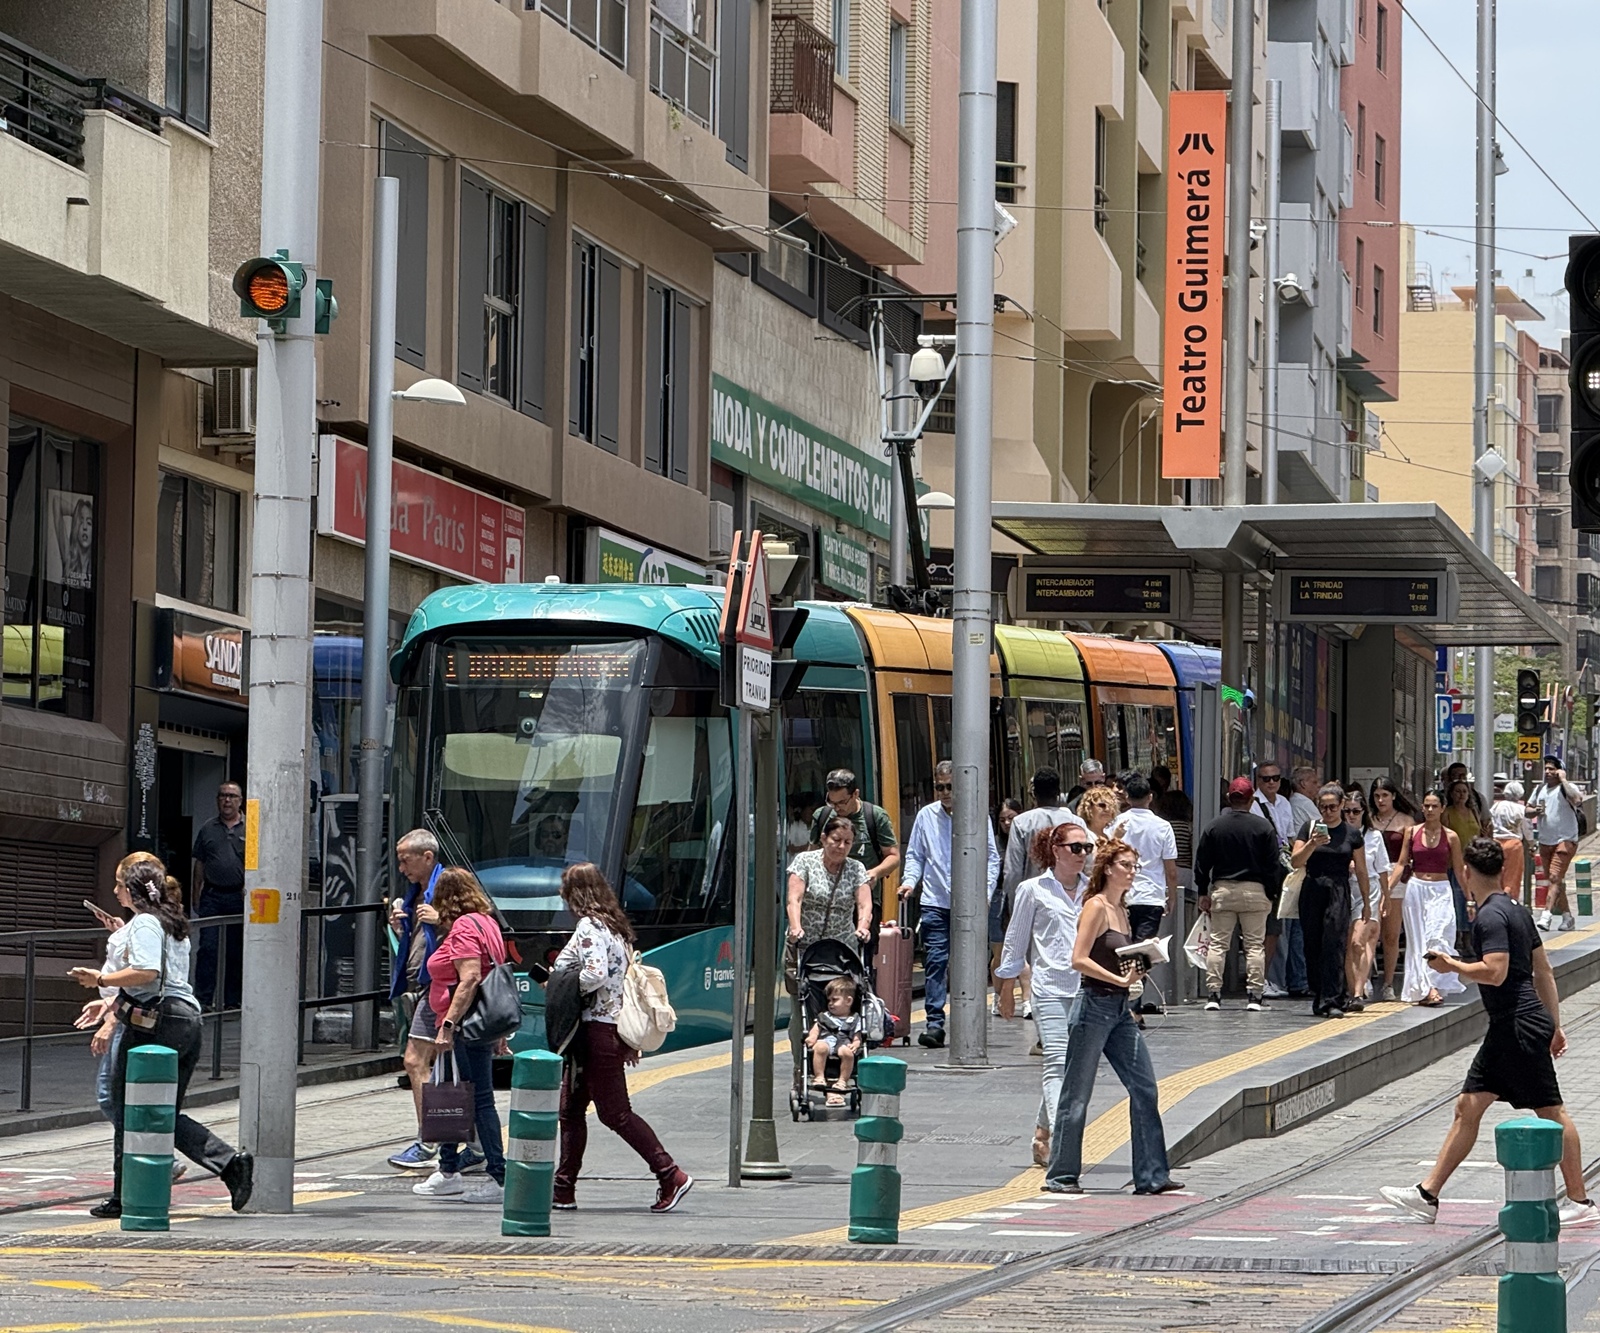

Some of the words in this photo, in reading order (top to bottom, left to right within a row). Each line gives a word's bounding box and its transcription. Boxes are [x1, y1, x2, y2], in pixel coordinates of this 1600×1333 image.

[1177, 169, 1211, 312] Guimerá
[1176, 324, 1208, 433] Teatro
[712, 388, 752, 460] MODA
[756, 412, 767, 464] Y
[769, 419, 869, 513] COMPLEMENTOS
[423, 495, 465, 554] Paris
[1036, 589, 1095, 597] INTERCAMBIADOR
[1300, 581, 1310, 589] LA
[1313, 581, 1344, 589] TRINIDAD
[1417, 582, 1428, 590] min
[1300, 591, 1310, 599] LA
[1313, 591, 1344, 599] TRINIDAD
[744, 655, 771, 677] PRIORIDAD
[1440, 699, 1450, 729] P
[1519, 742, 1539, 754] 25
[254, 893, 270, 918] T
